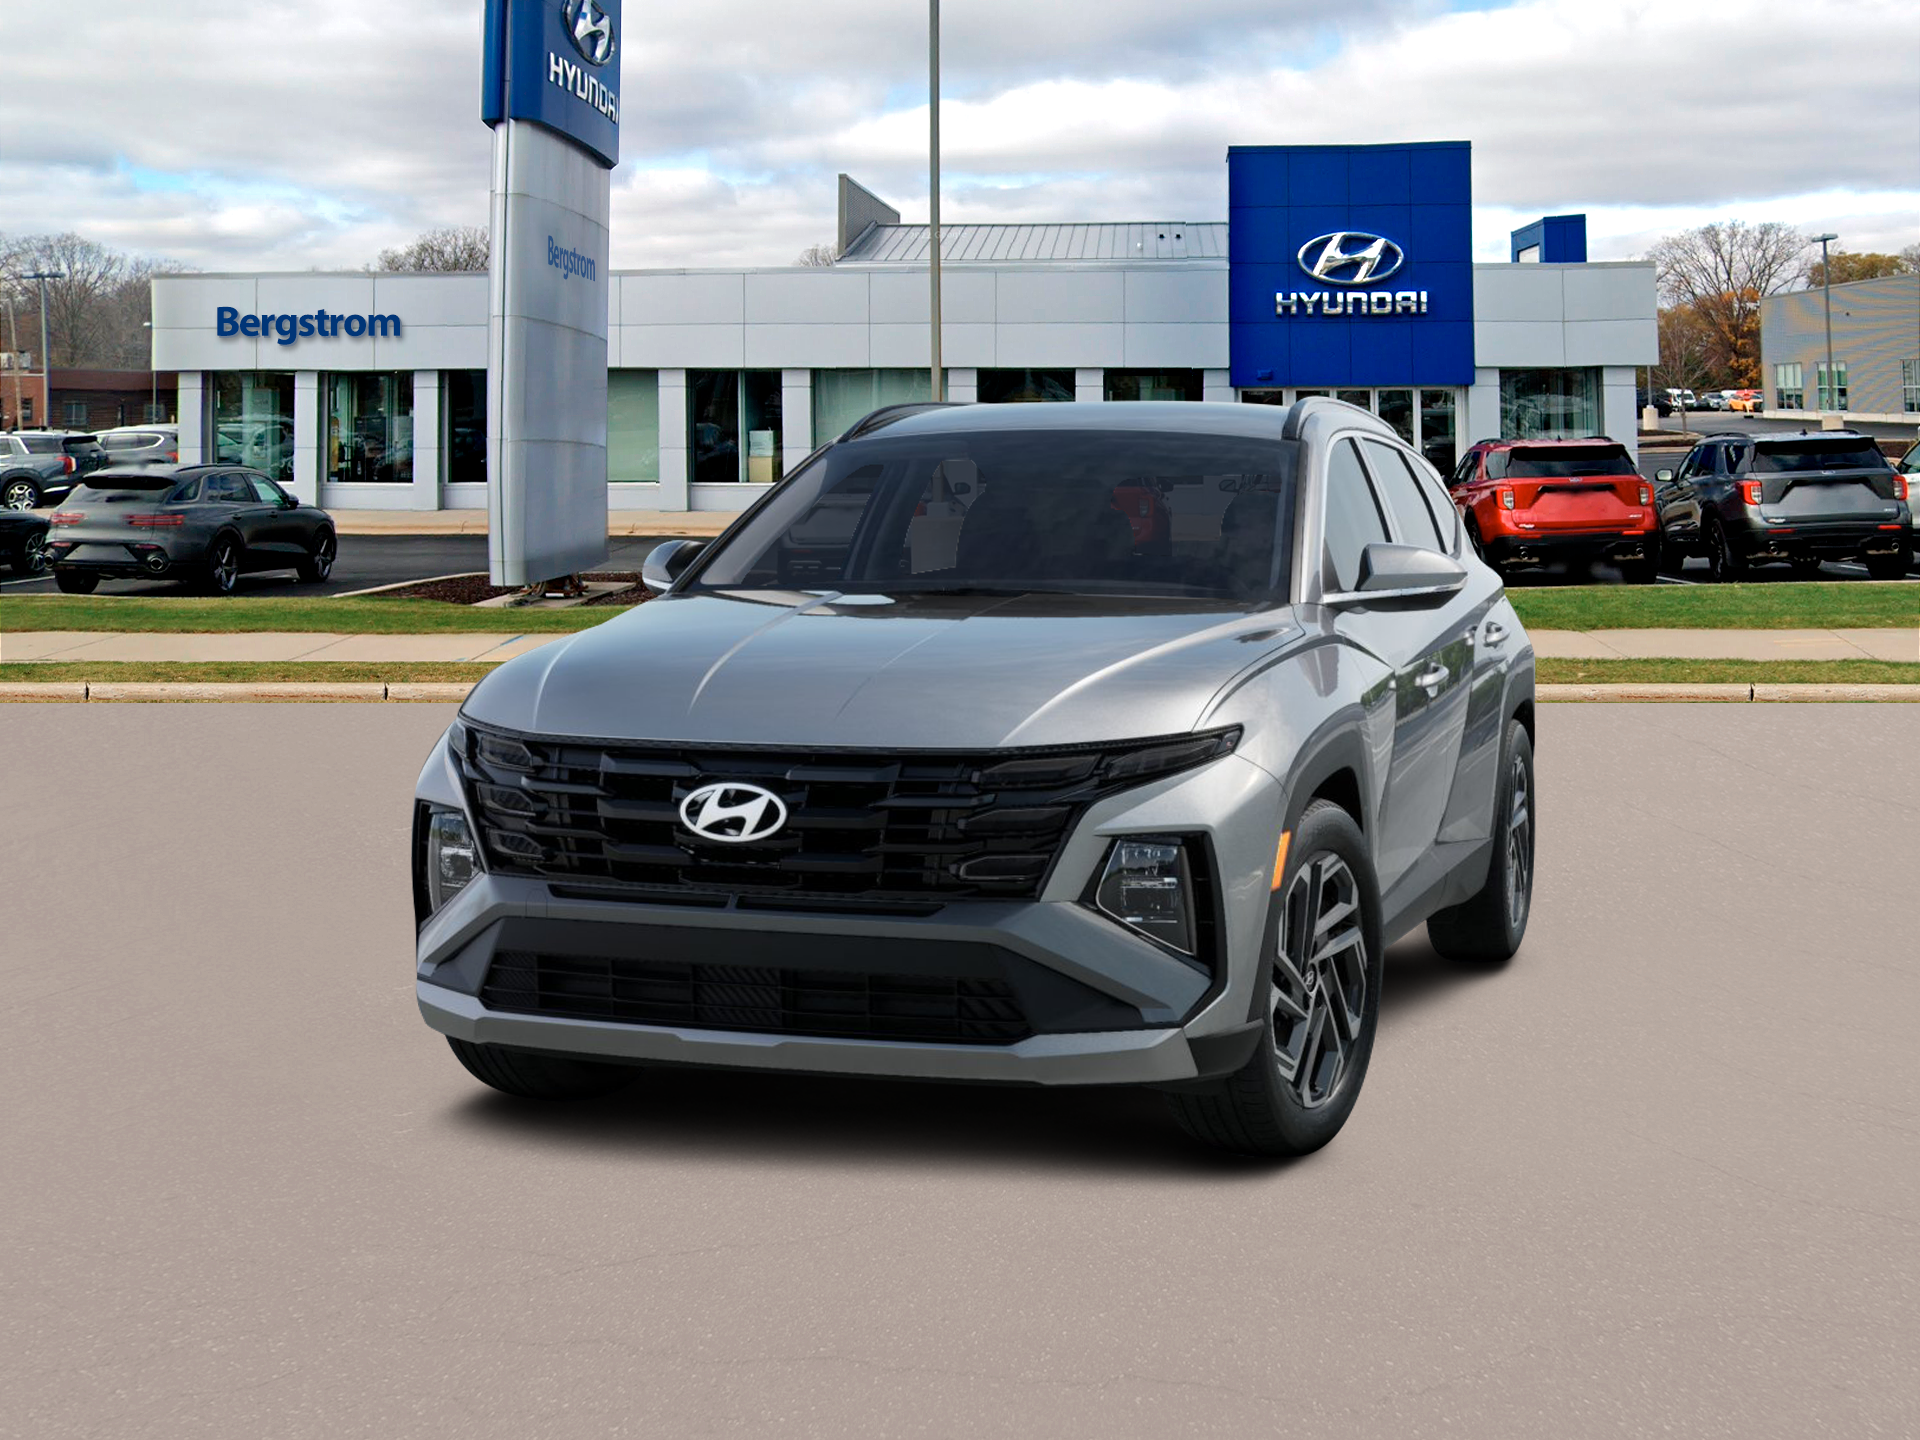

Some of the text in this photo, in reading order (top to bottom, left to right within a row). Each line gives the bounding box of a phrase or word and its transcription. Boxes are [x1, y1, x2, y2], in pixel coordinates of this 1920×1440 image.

[548, 52, 619, 124] HYUNDAI
[547, 235, 596, 282] Bergstrom
[1275, 291, 1428, 315] HYUNDAI
[217, 306, 402, 346] Bergstrom
